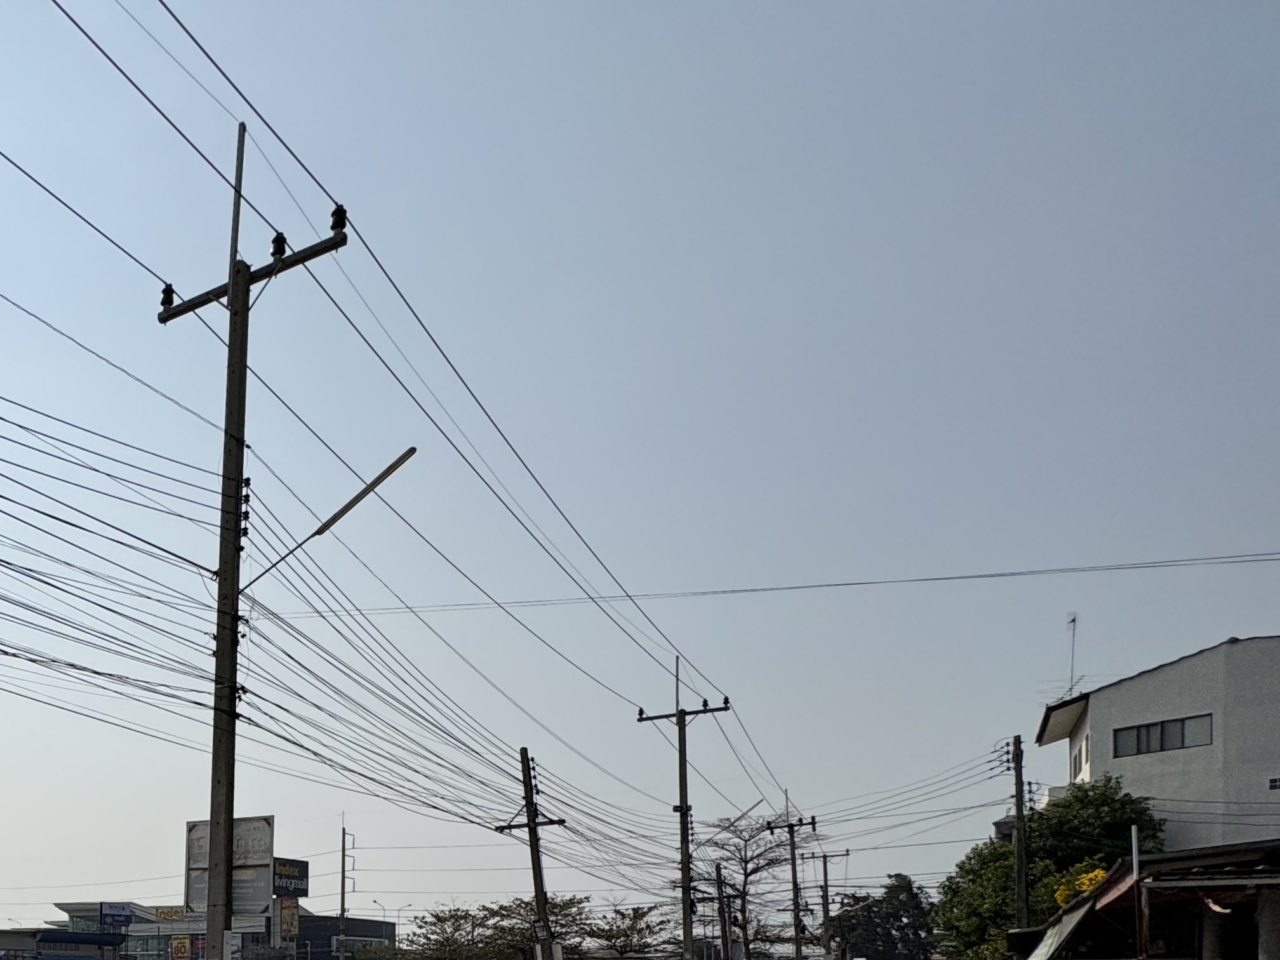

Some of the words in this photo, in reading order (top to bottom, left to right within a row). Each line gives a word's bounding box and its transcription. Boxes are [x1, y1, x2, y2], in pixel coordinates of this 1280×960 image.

[275, 863, 299, 876] Index
[275, 875, 307, 891] livingmall
[174, 945, 186, 955] 80
